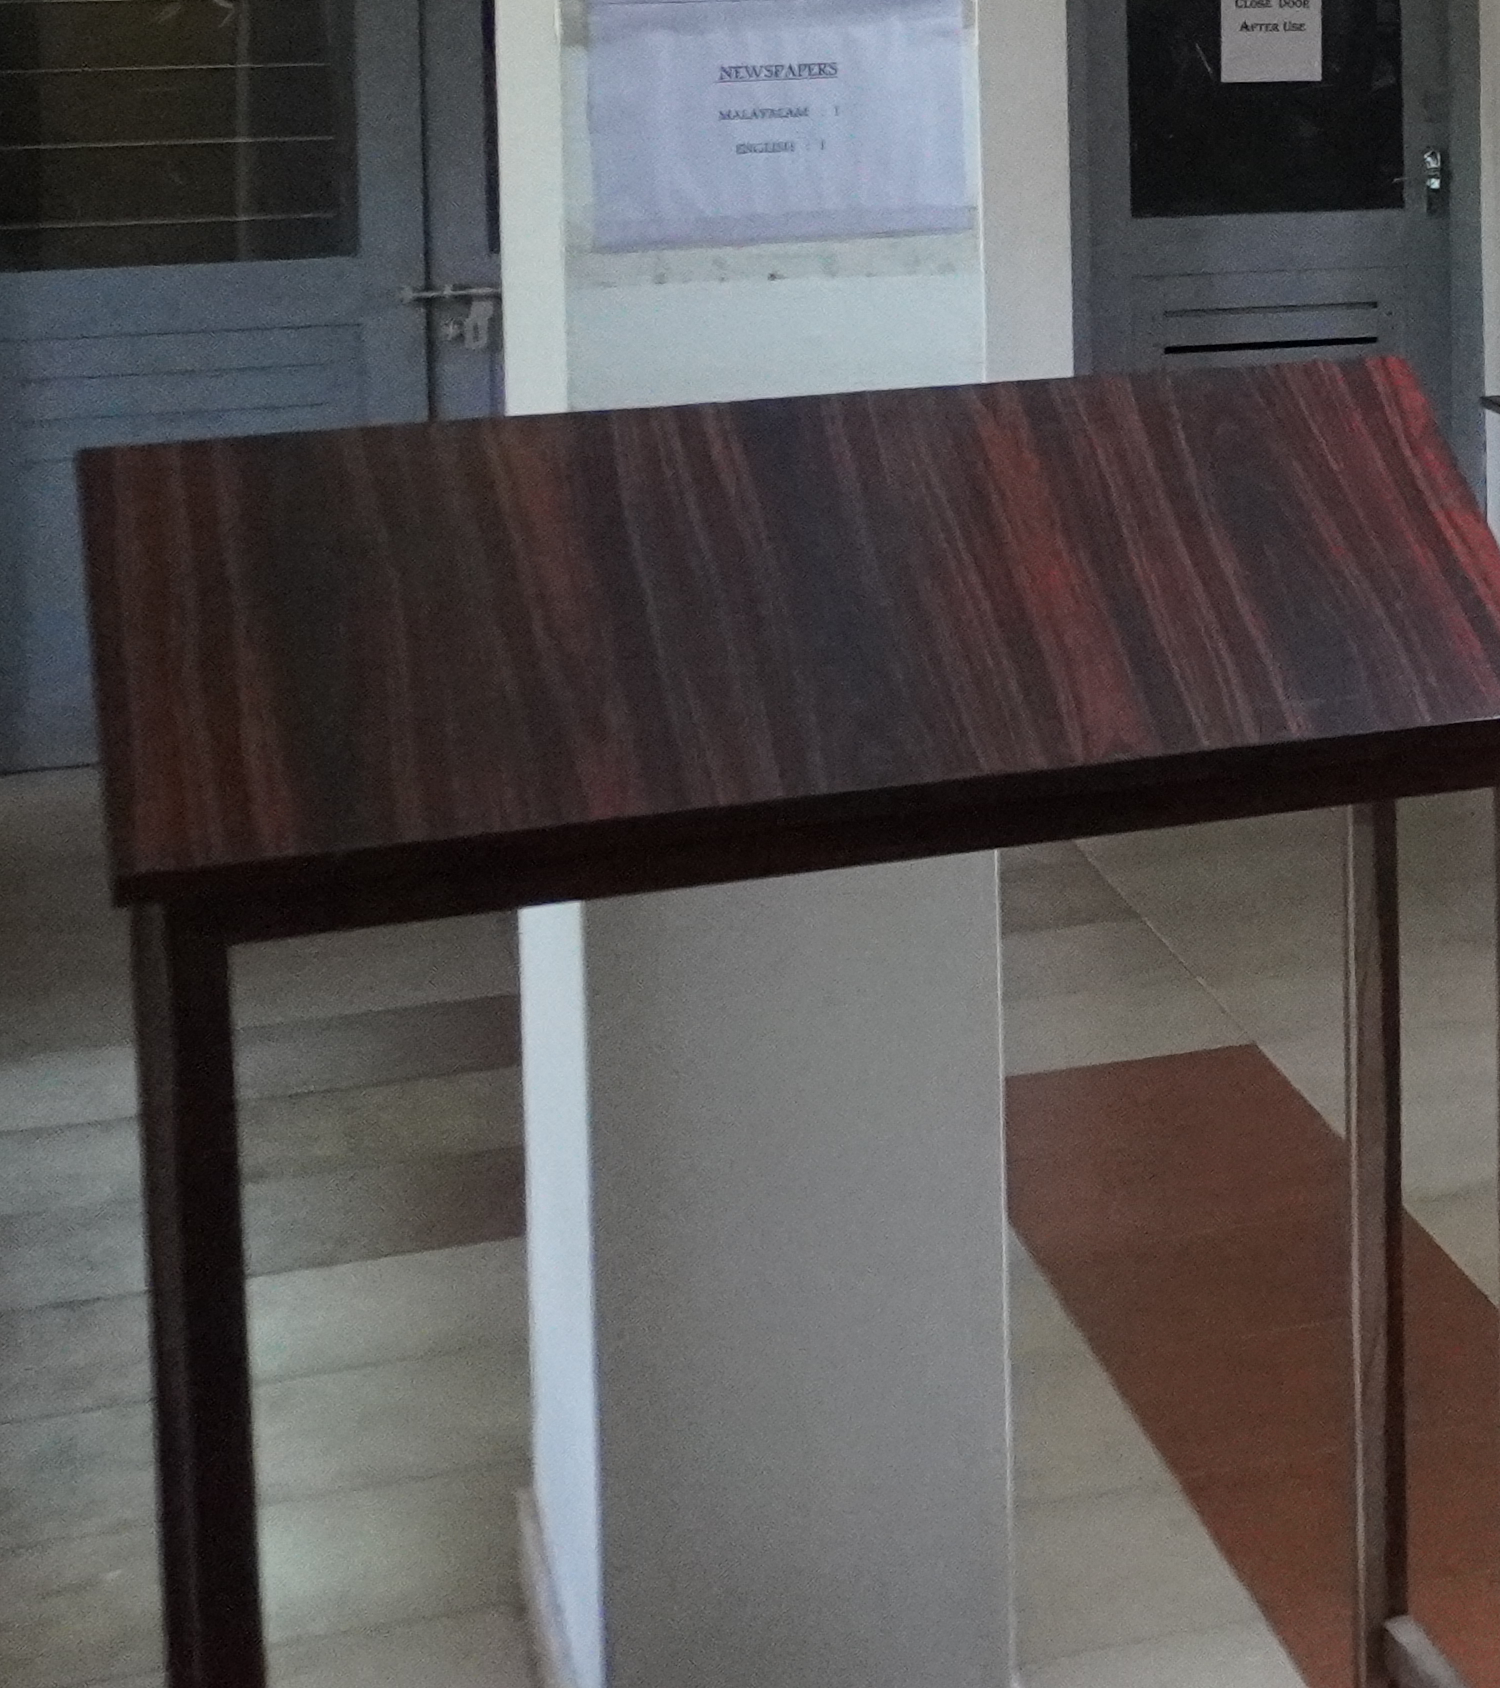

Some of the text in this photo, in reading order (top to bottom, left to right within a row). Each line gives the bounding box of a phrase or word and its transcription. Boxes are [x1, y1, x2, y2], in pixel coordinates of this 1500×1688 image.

[1239, 19, 1307, 32] AFTER USE
[716, 62, 839, 82] NEWSPAPERS
[735, 140, 796, 155] ENGLISH
